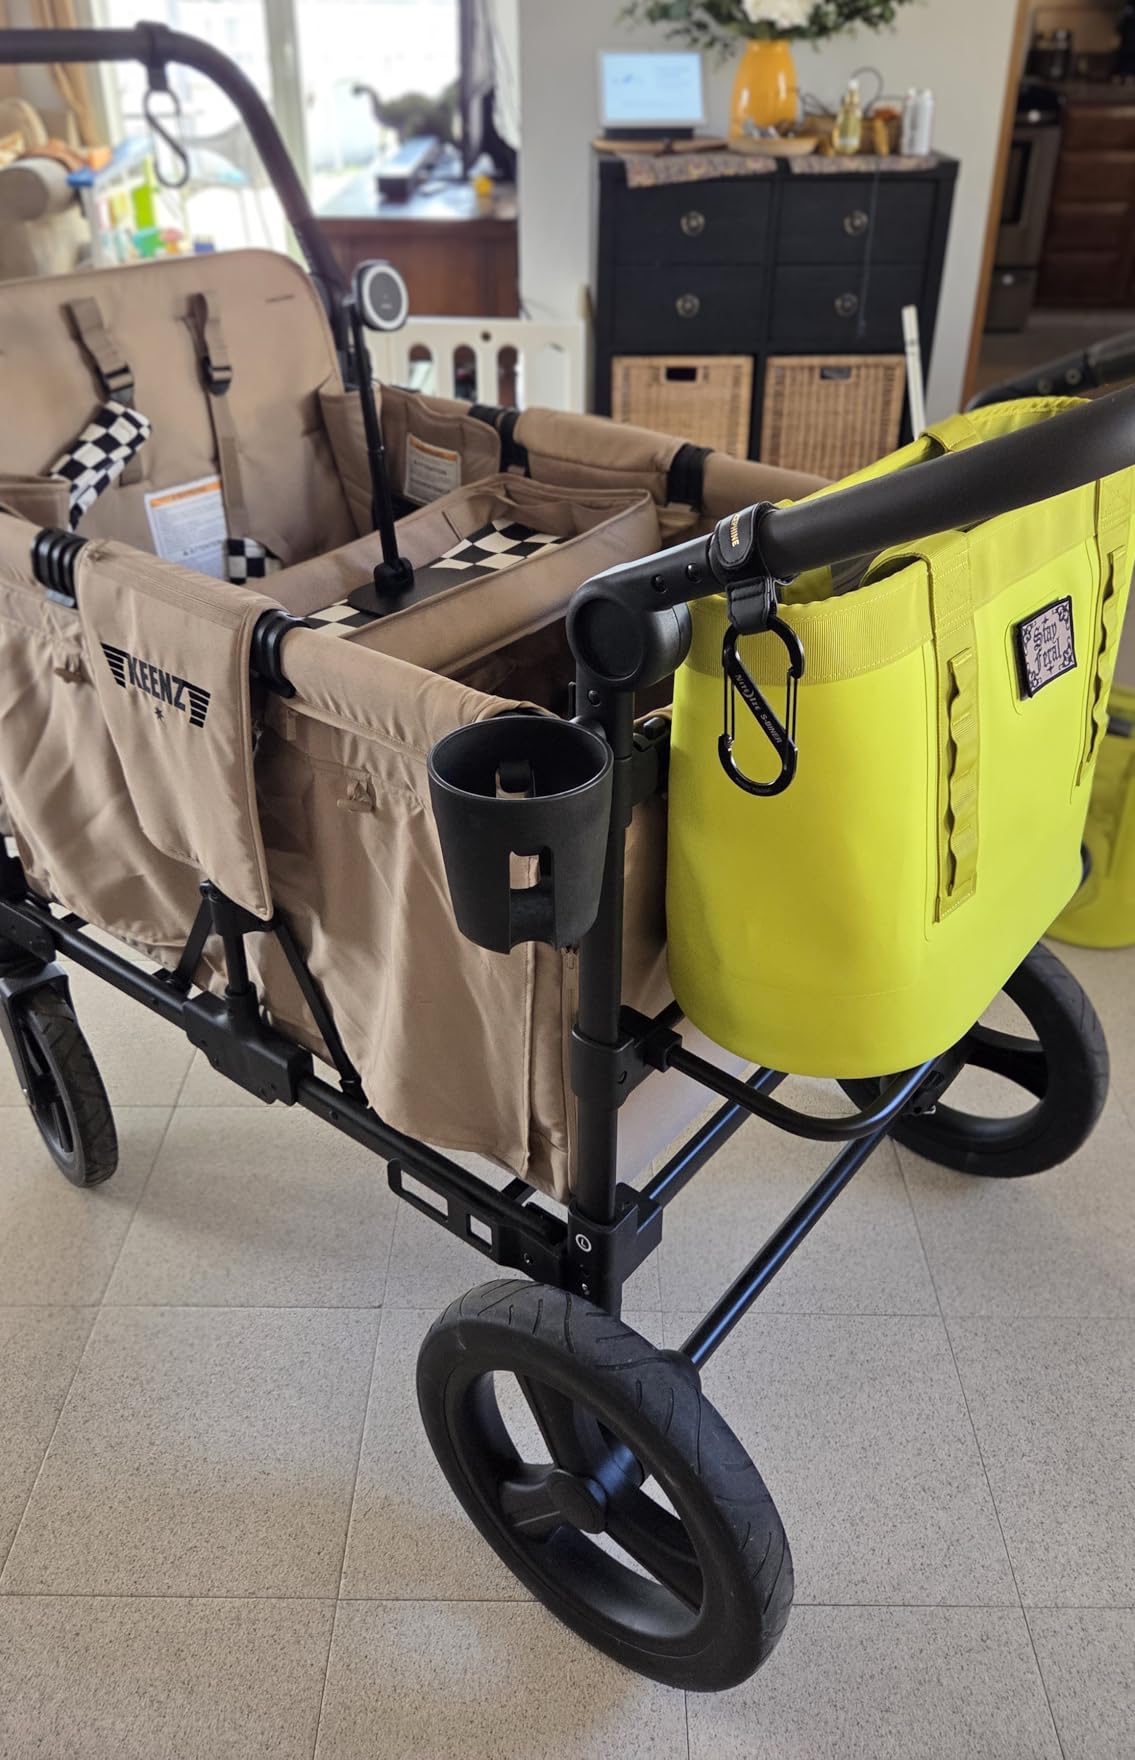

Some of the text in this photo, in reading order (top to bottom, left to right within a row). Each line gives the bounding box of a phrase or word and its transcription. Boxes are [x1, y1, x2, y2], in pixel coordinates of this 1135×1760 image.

[1033, 621, 1058, 644] Stay
[1034, 637, 1063, 676] Feral
[127, 654, 186, 712] KEENZ
